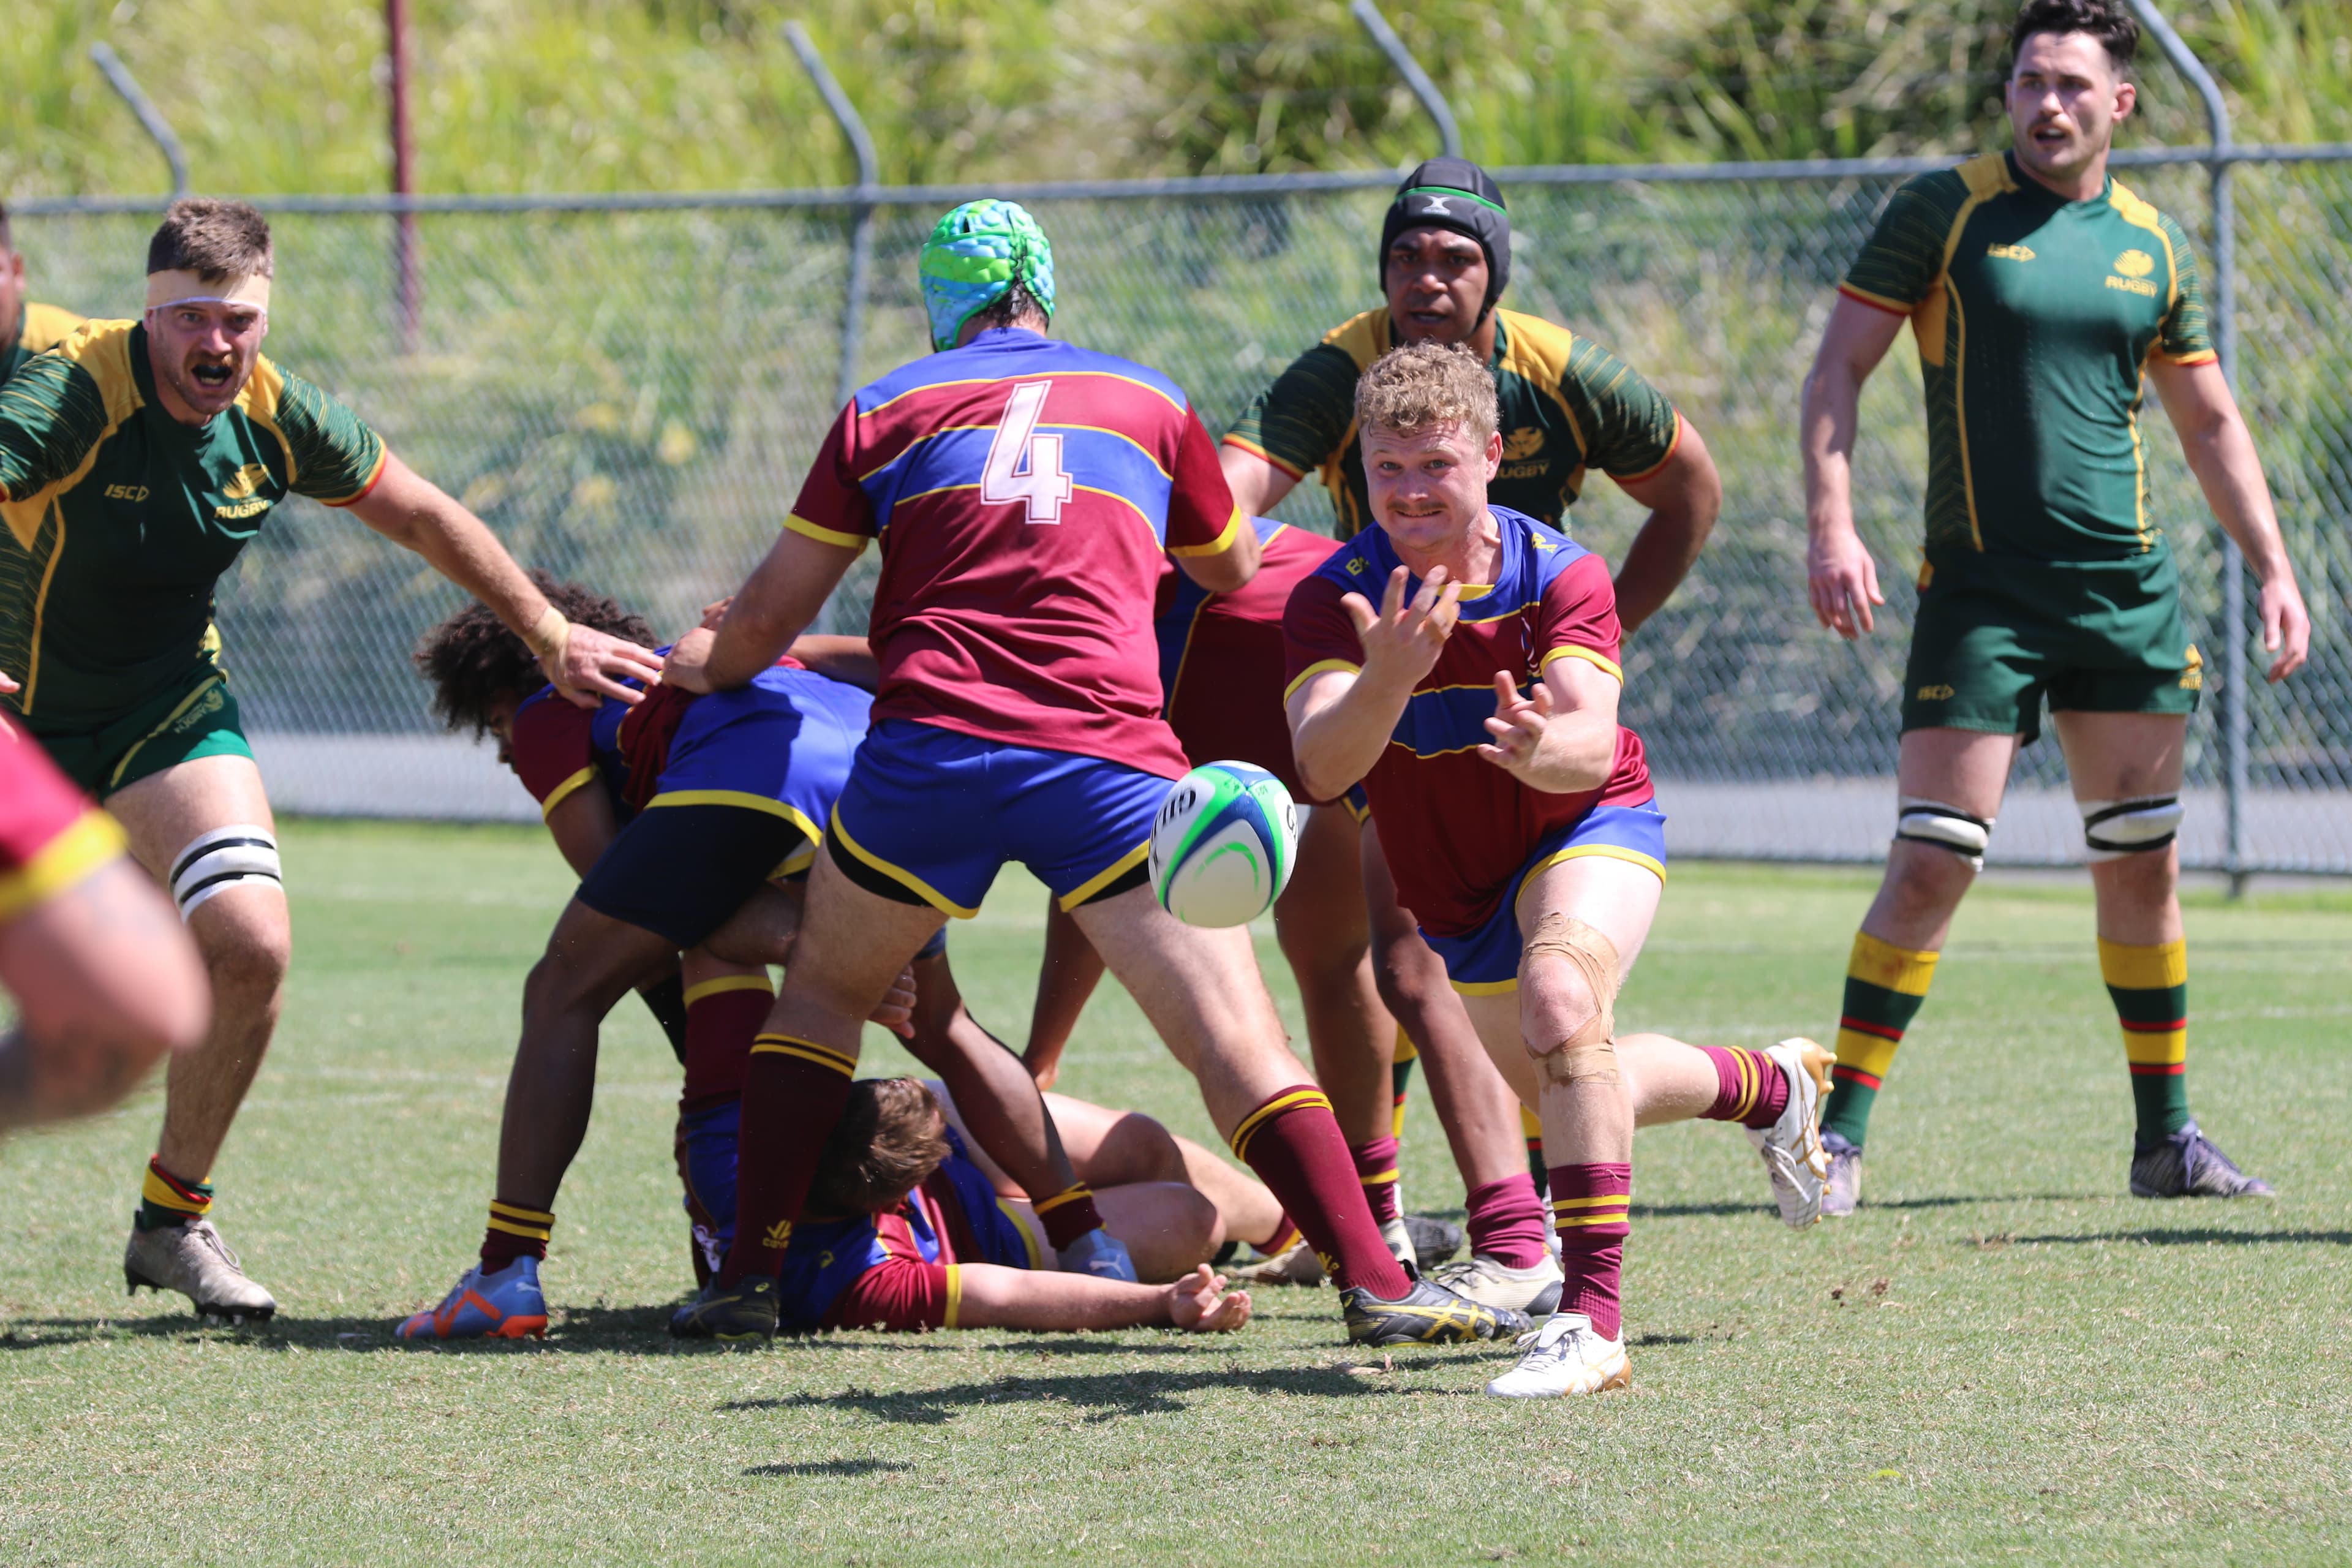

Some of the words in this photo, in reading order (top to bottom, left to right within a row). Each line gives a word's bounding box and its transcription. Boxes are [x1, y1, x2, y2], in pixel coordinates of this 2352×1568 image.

[2105, 275, 2158, 298] RUGBY
[980, 379, 1072, 525] 4
[1498, 463, 1550, 479] UGBY
[214, 499, 270, 519] RUGBY
